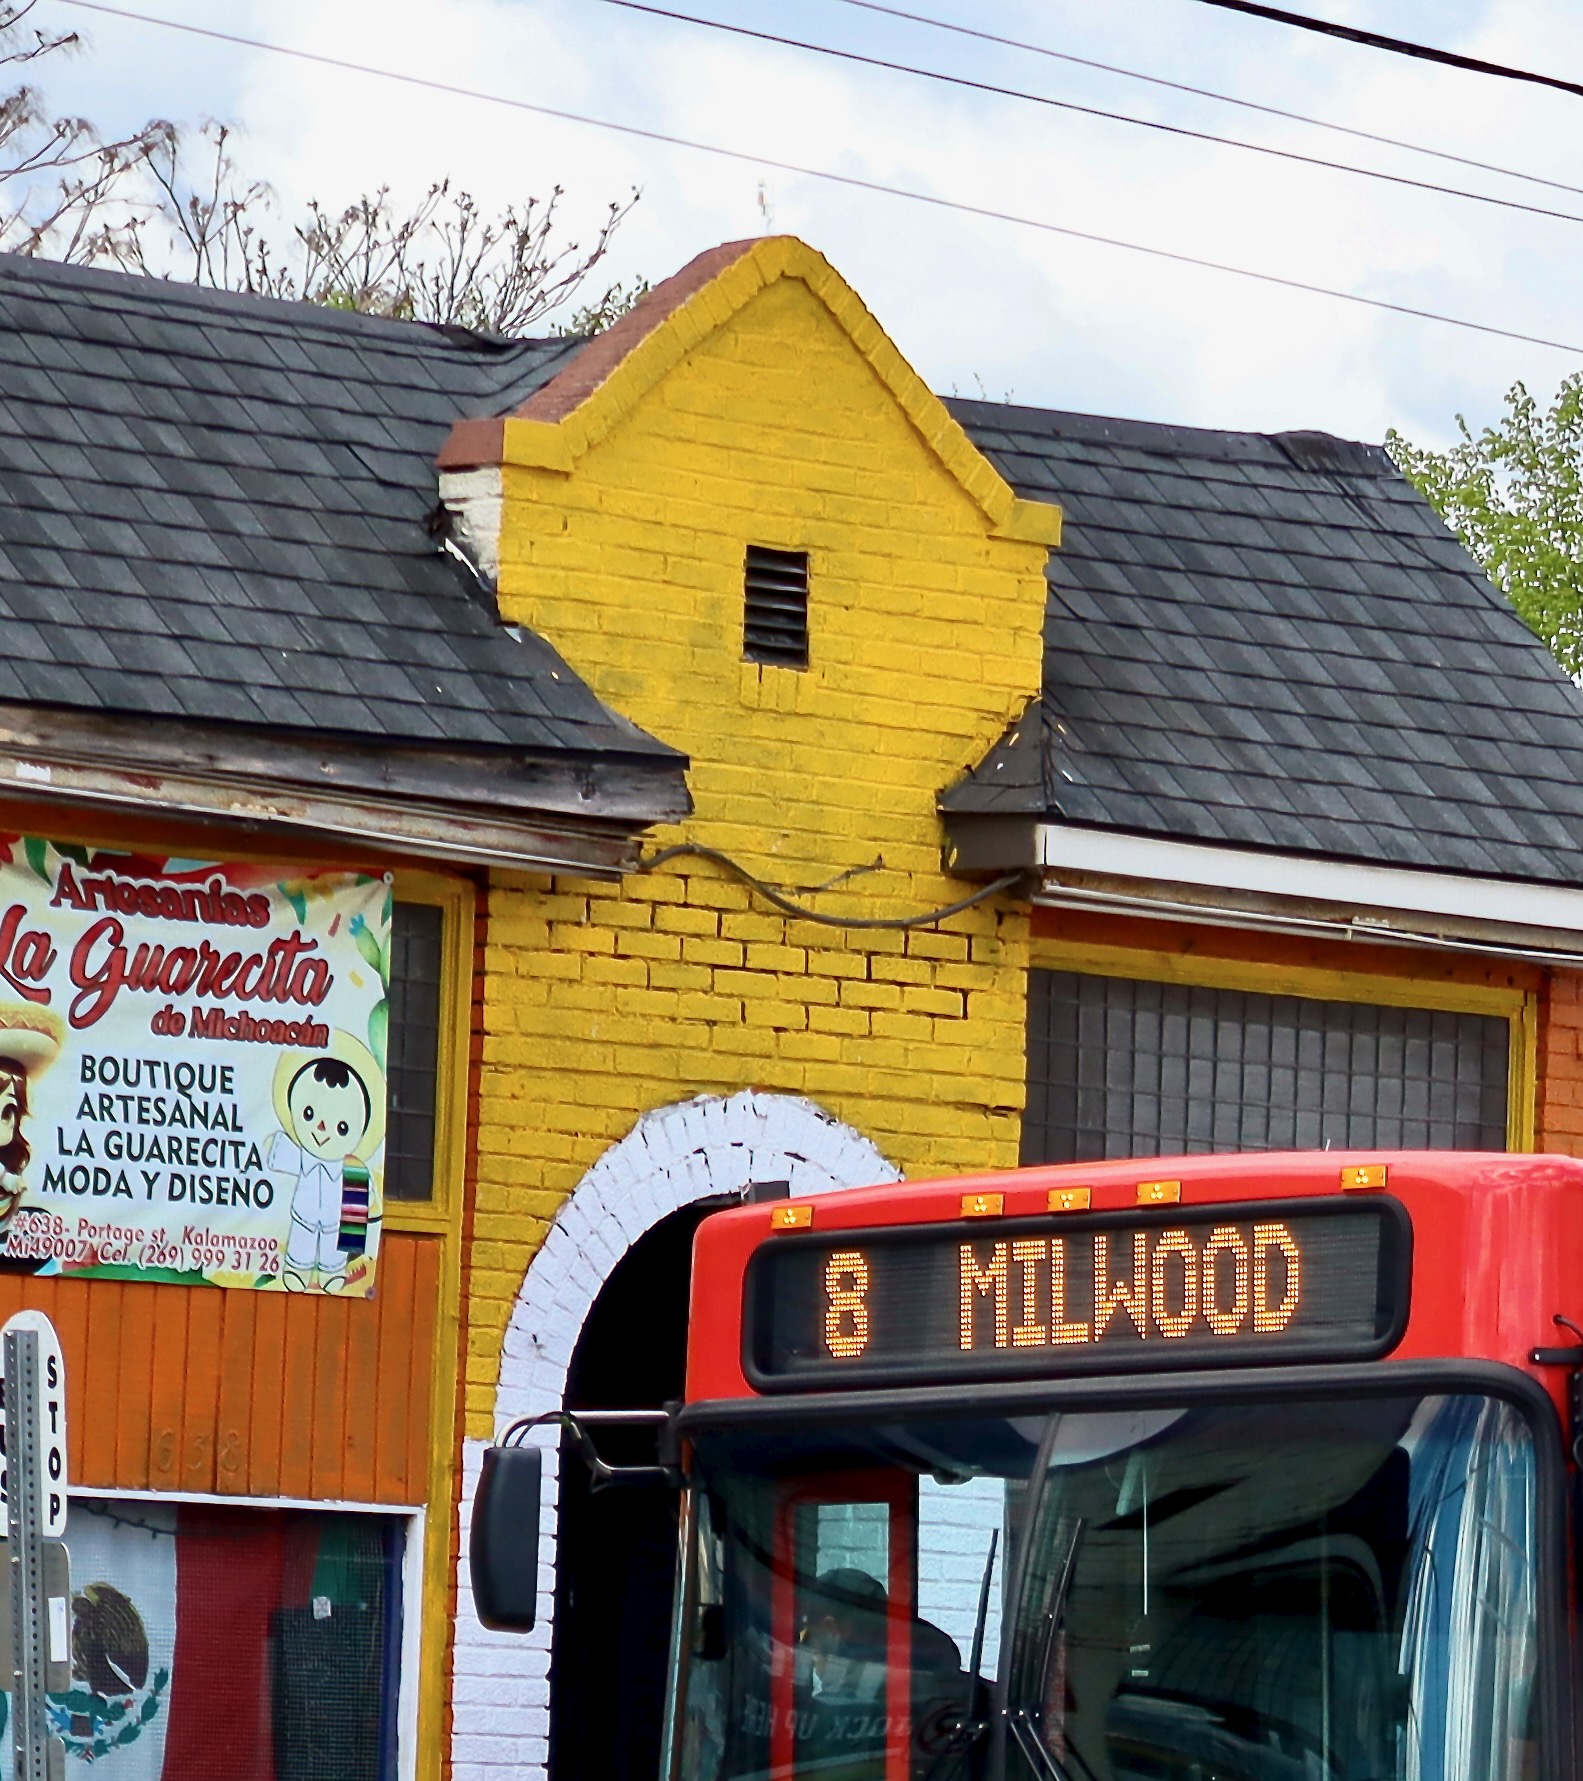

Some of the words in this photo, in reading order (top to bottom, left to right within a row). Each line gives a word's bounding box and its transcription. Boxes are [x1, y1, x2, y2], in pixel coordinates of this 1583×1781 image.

[0, 904, 57, 1005] La
[68, 916, 334, 1030] Guarecita
[151, 1004, 186, 1037] de
[80, 1053, 235, 1100] BOUTIQUE
[76, 1092, 244, 1133] ARTESANAL
[57, 1126, 95, 1159] LA
[103, 1130, 263, 1172] GUARECITA
[42, 1163, 133, 1200] MODA
[140, 1170, 161, 1200] Y
[77, 1217, 145, 1246] Portage
[182, 1225, 278, 1251] Kalamazoo
[100, 1241, 131, 1263] Cel.
[138, 1244, 184, 1269] (269)
[191, 1247, 225, 1268] 999
[231, 1250, 251, 1271] 31
[258, 1252, 279, 1273] 26
[824, 1252, 869, 1358] 8
[958, 1223, 1299, 1351] MILWOOD
[47, 1355, 61, 1526] STOP
